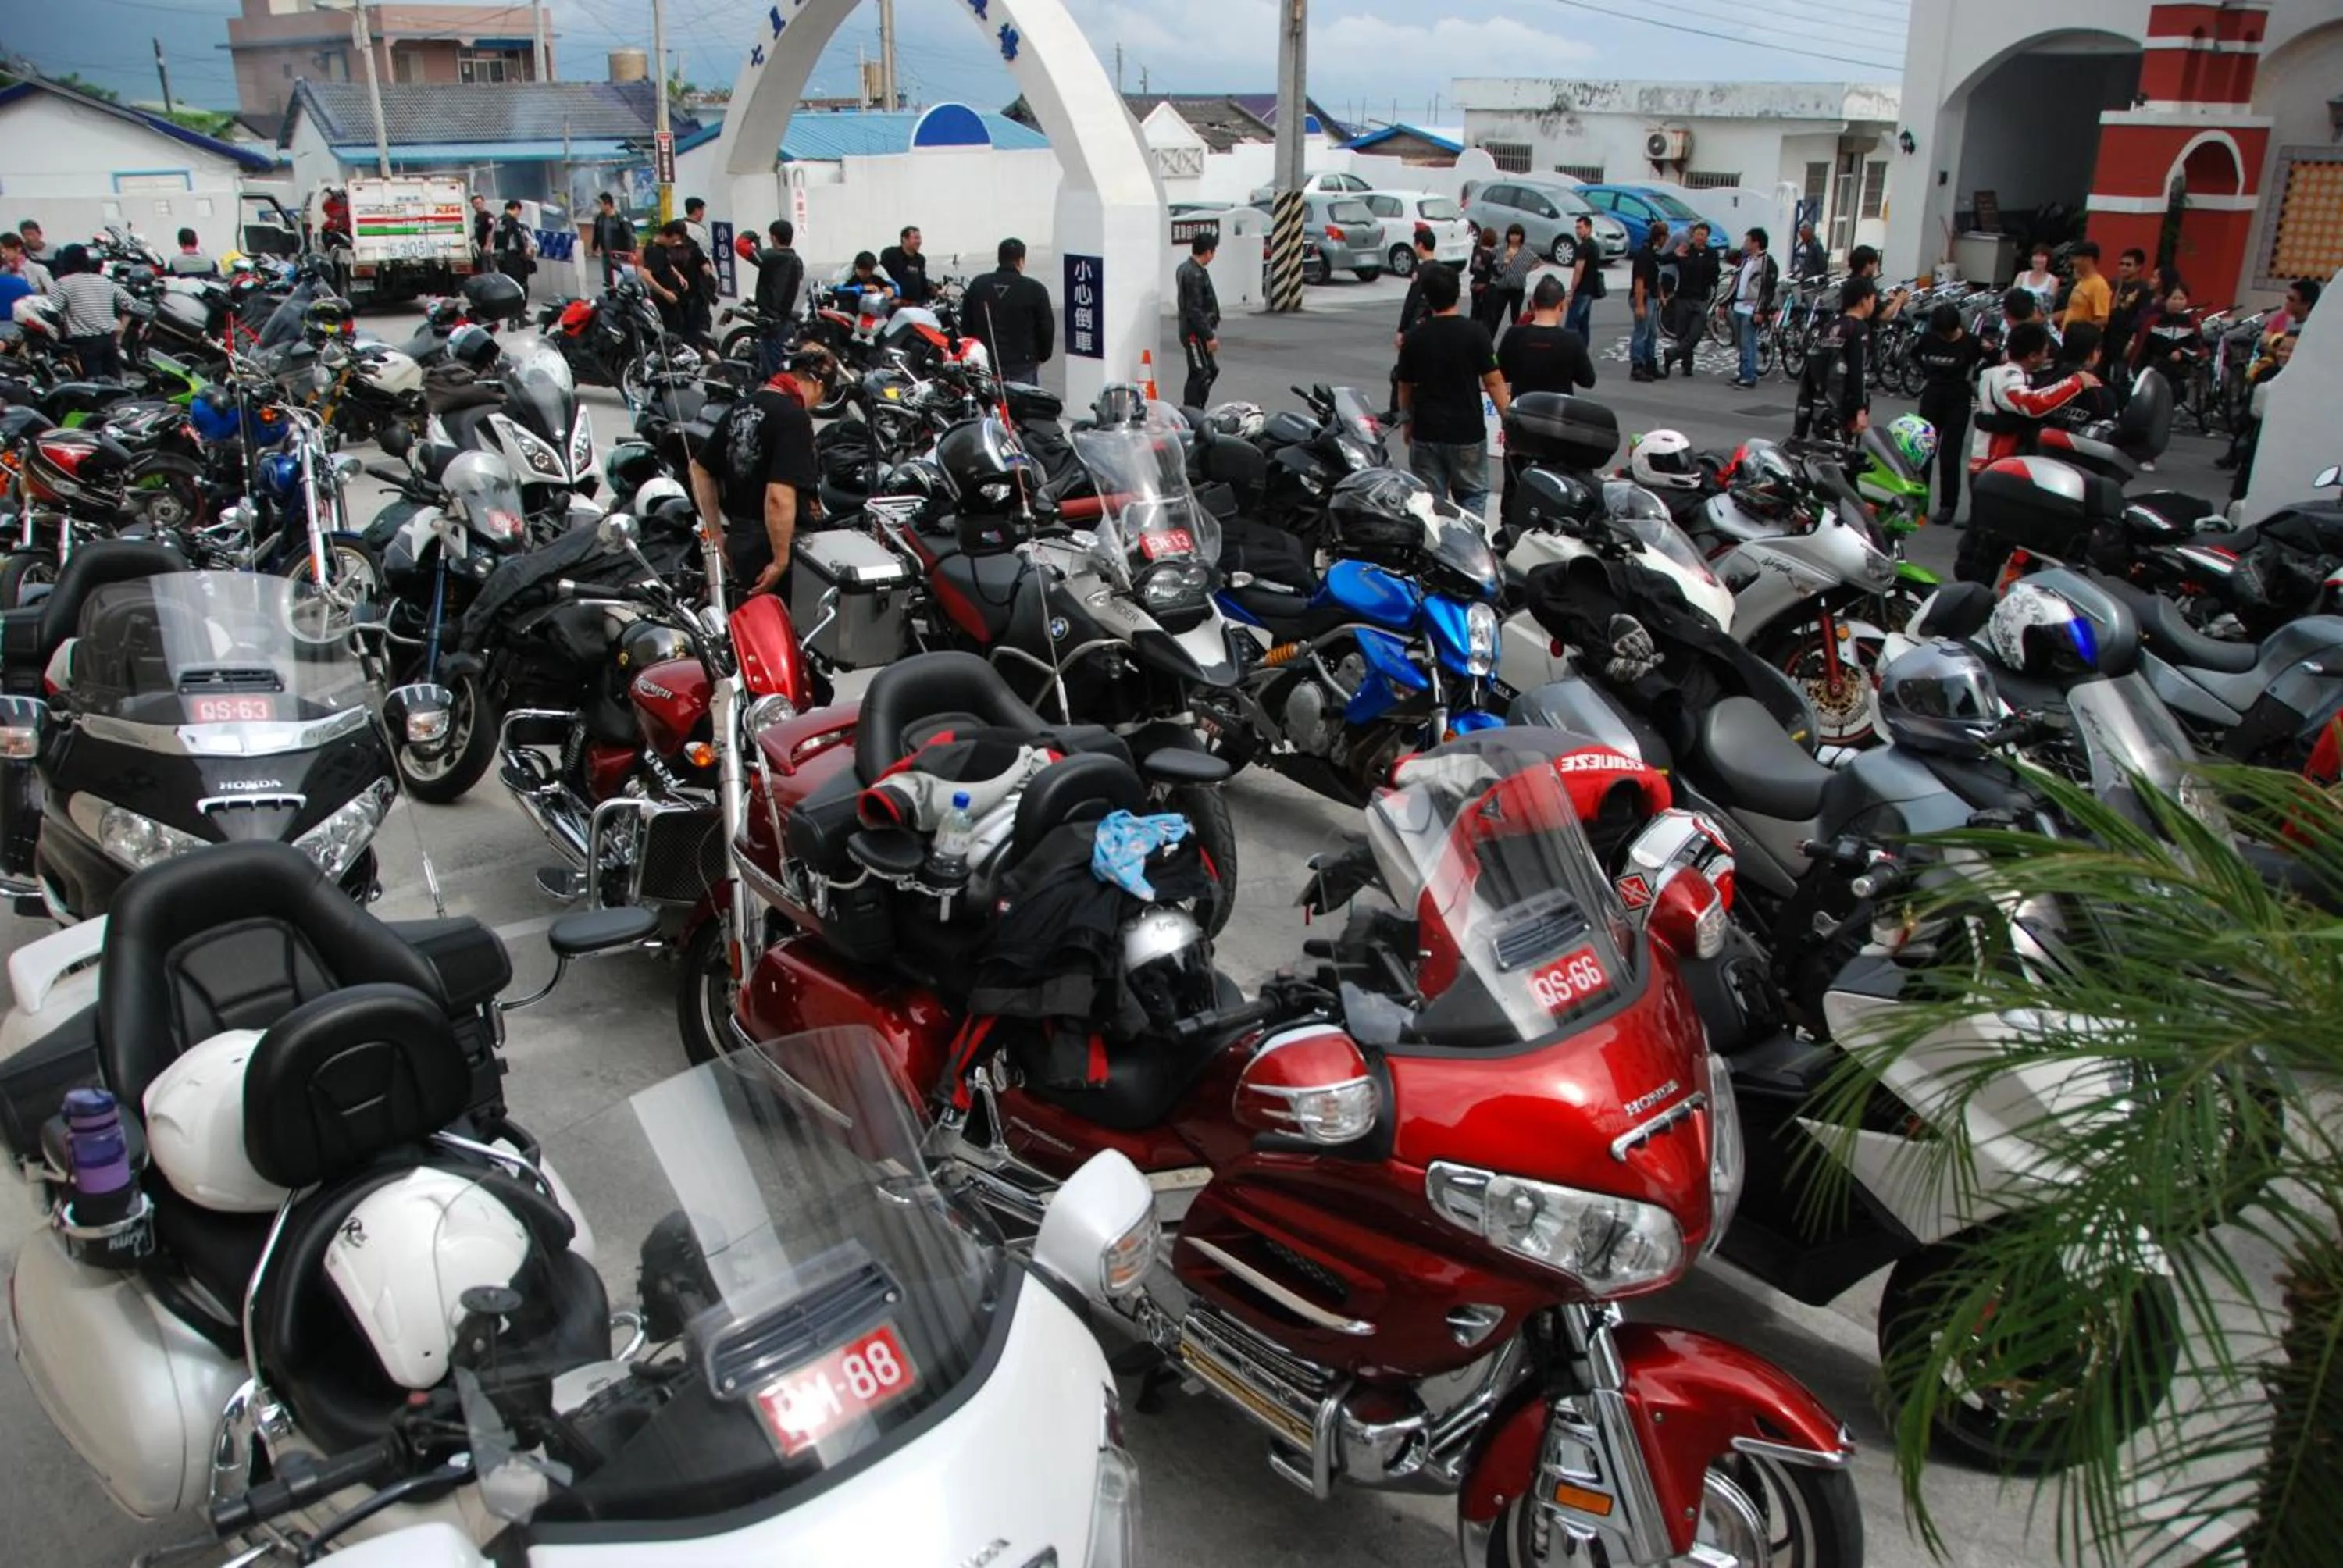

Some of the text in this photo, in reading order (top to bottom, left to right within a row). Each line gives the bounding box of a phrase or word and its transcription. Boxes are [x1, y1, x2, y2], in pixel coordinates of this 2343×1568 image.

[1074, 260, 1093, 351] 小心倒車
[1560, 754, 1645, 772] DAINESE
[219, 779, 283, 790] HONDA
[1534, 955, 1603, 1007] QS-66
[1624, 1080, 1679, 1117] HONDA
